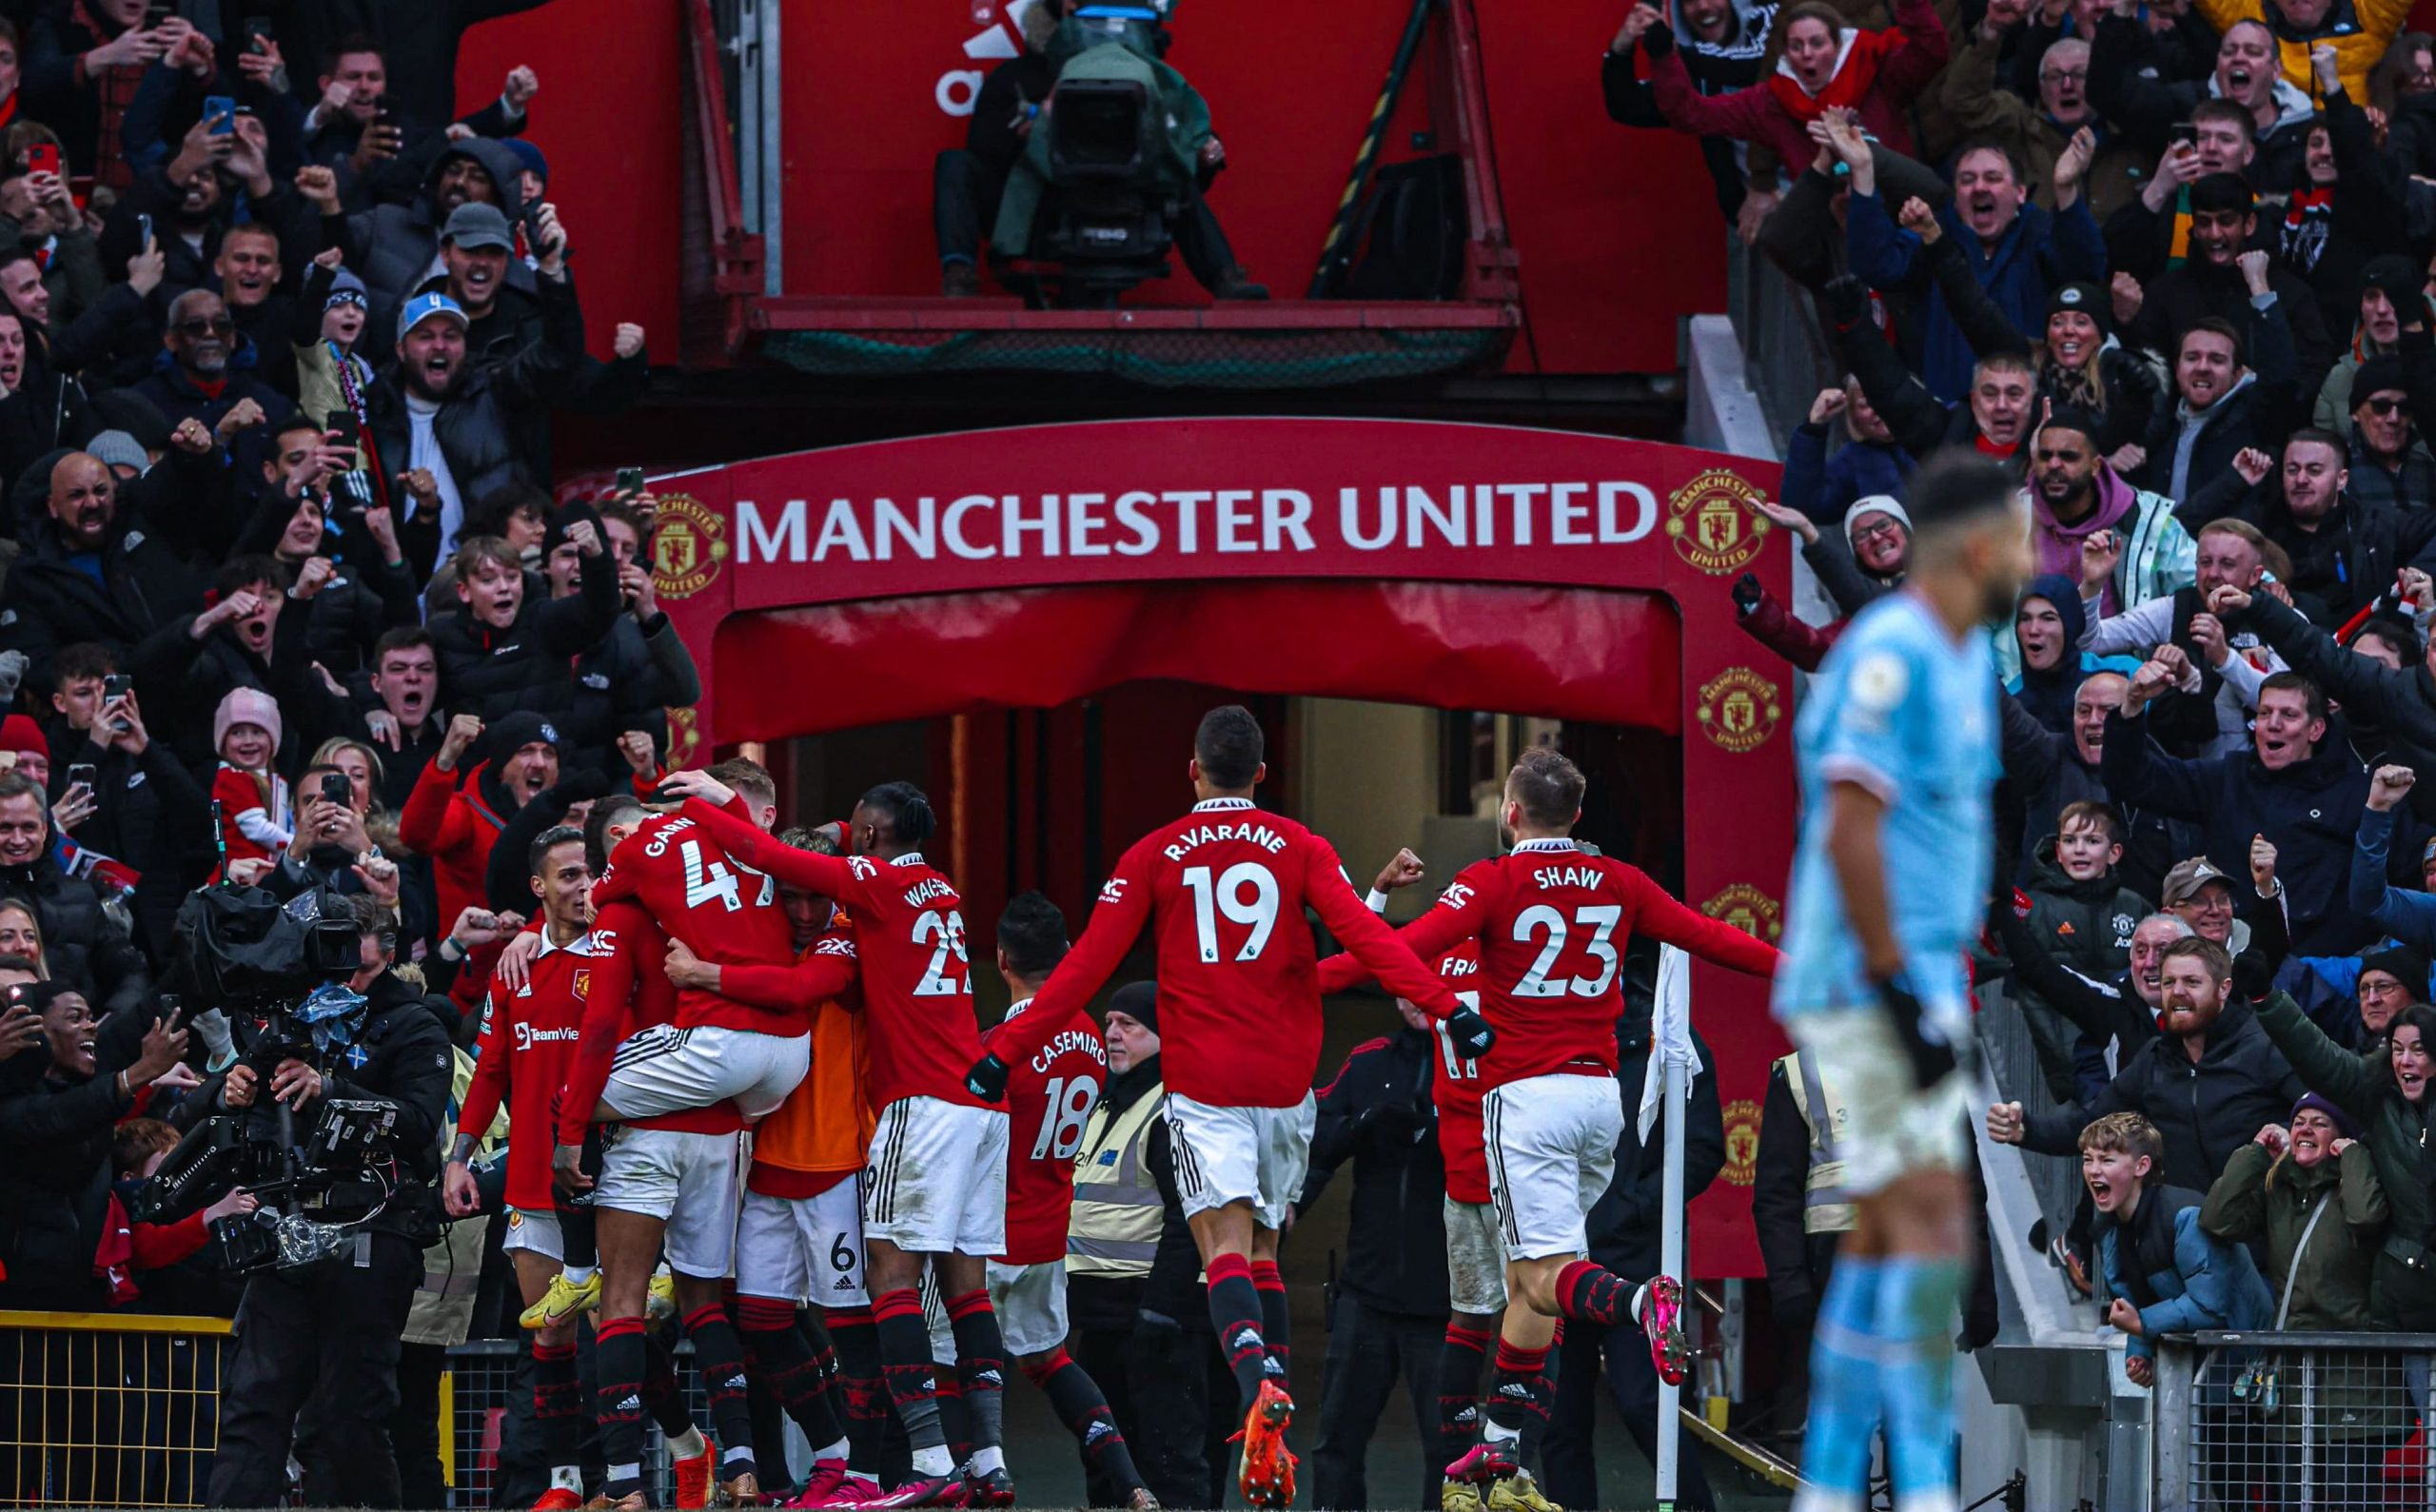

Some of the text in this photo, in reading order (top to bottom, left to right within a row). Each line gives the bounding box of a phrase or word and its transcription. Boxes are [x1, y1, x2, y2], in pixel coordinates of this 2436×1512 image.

[1677, 477, 1756, 511] MANCHESTE
[737, 481, 1658, 563] MANCHESTER UNITED
[1691, 549, 1749, 567] UNITED
[1164, 822, 1287, 862] R.VARANE
[1533, 866, 1603, 891] SHAW
[1182, 861, 1280, 963] 19
[1511, 904, 1621, 997] 23
[1031, 1031, 1107, 1073] CASEMIRO
[1031, 1074, 1099, 1159] 18
[831, 1232, 856, 1272] 6
